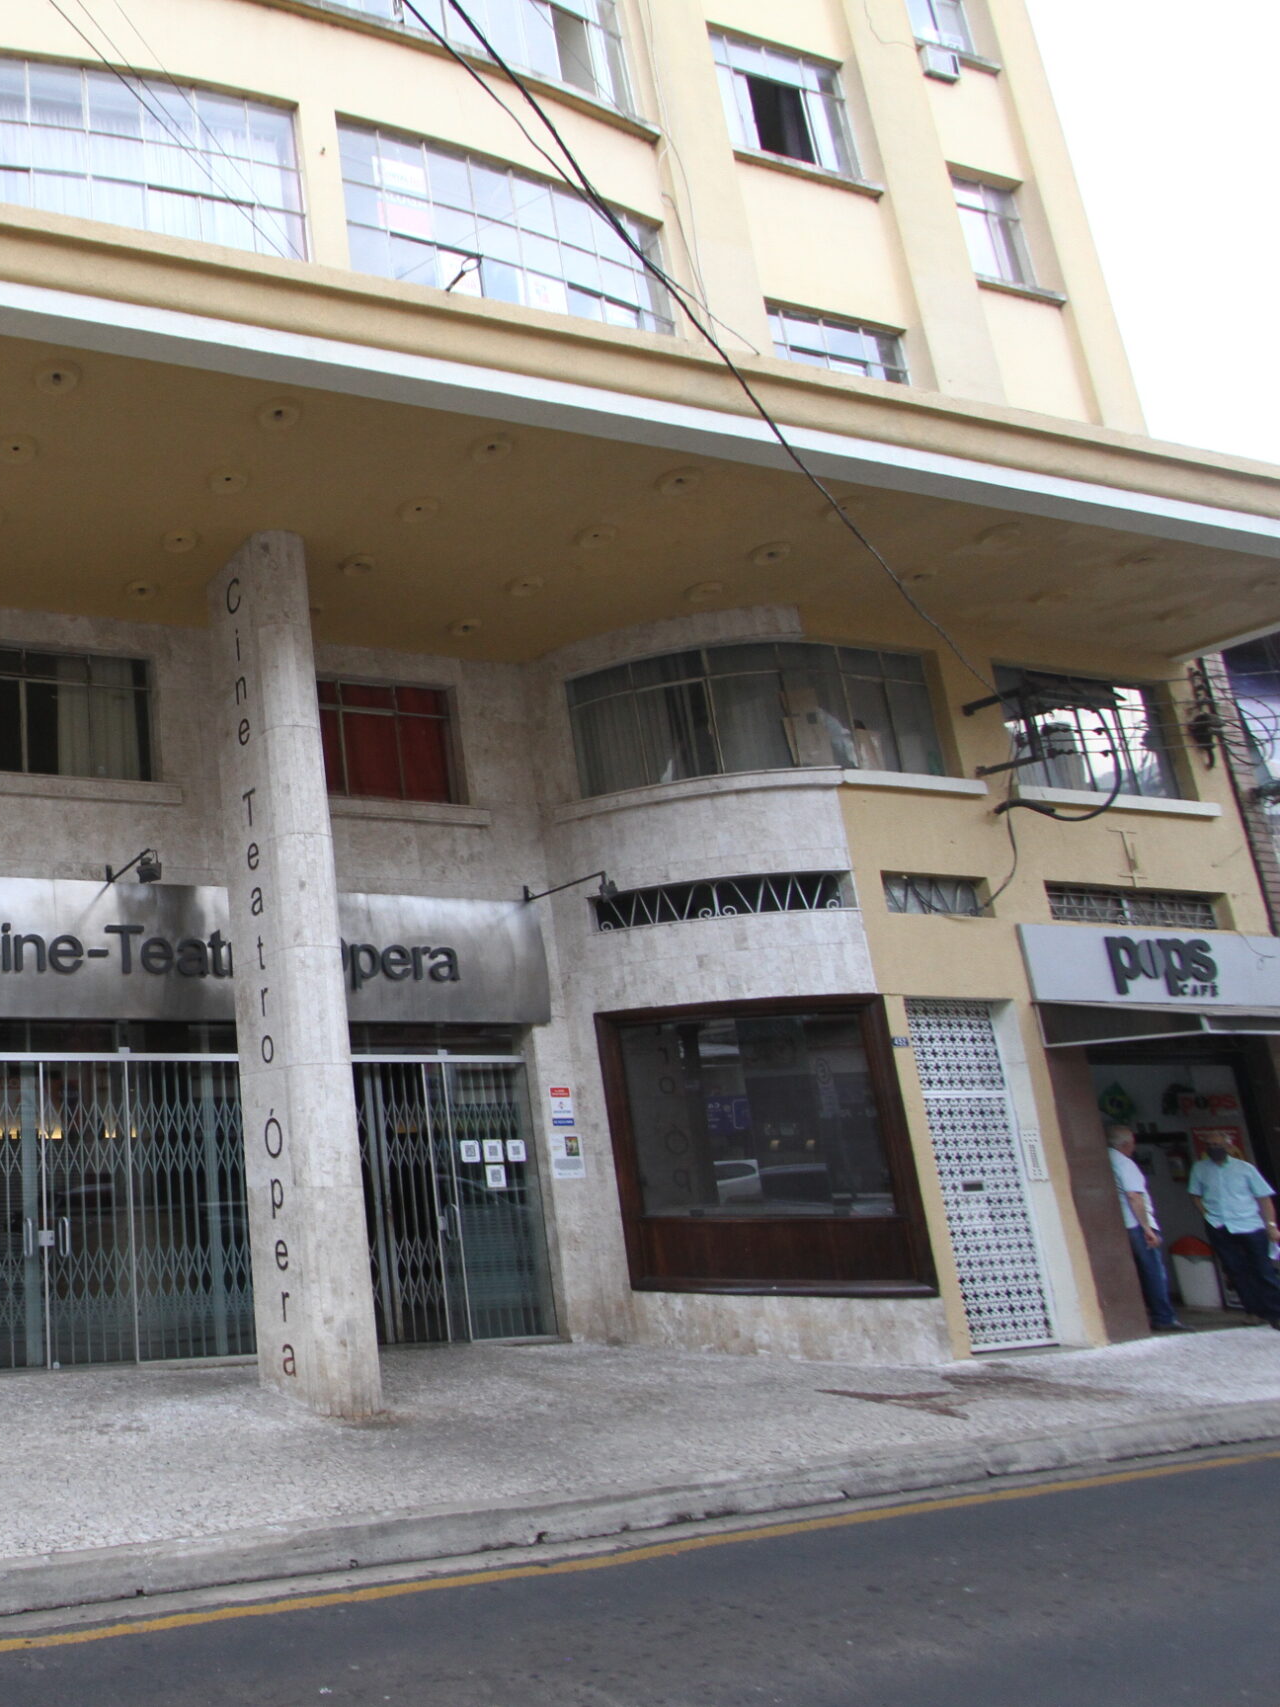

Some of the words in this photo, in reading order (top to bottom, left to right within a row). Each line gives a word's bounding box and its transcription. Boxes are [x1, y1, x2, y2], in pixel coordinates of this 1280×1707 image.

[226, 577, 250, 746] Cine
[242, 788, 274, 1064] Teatro
[264, 1108, 297, 1378] Ópera
[1104, 936, 1218, 996] pops
[1180, 981, 1219, 998] CAFÉ
